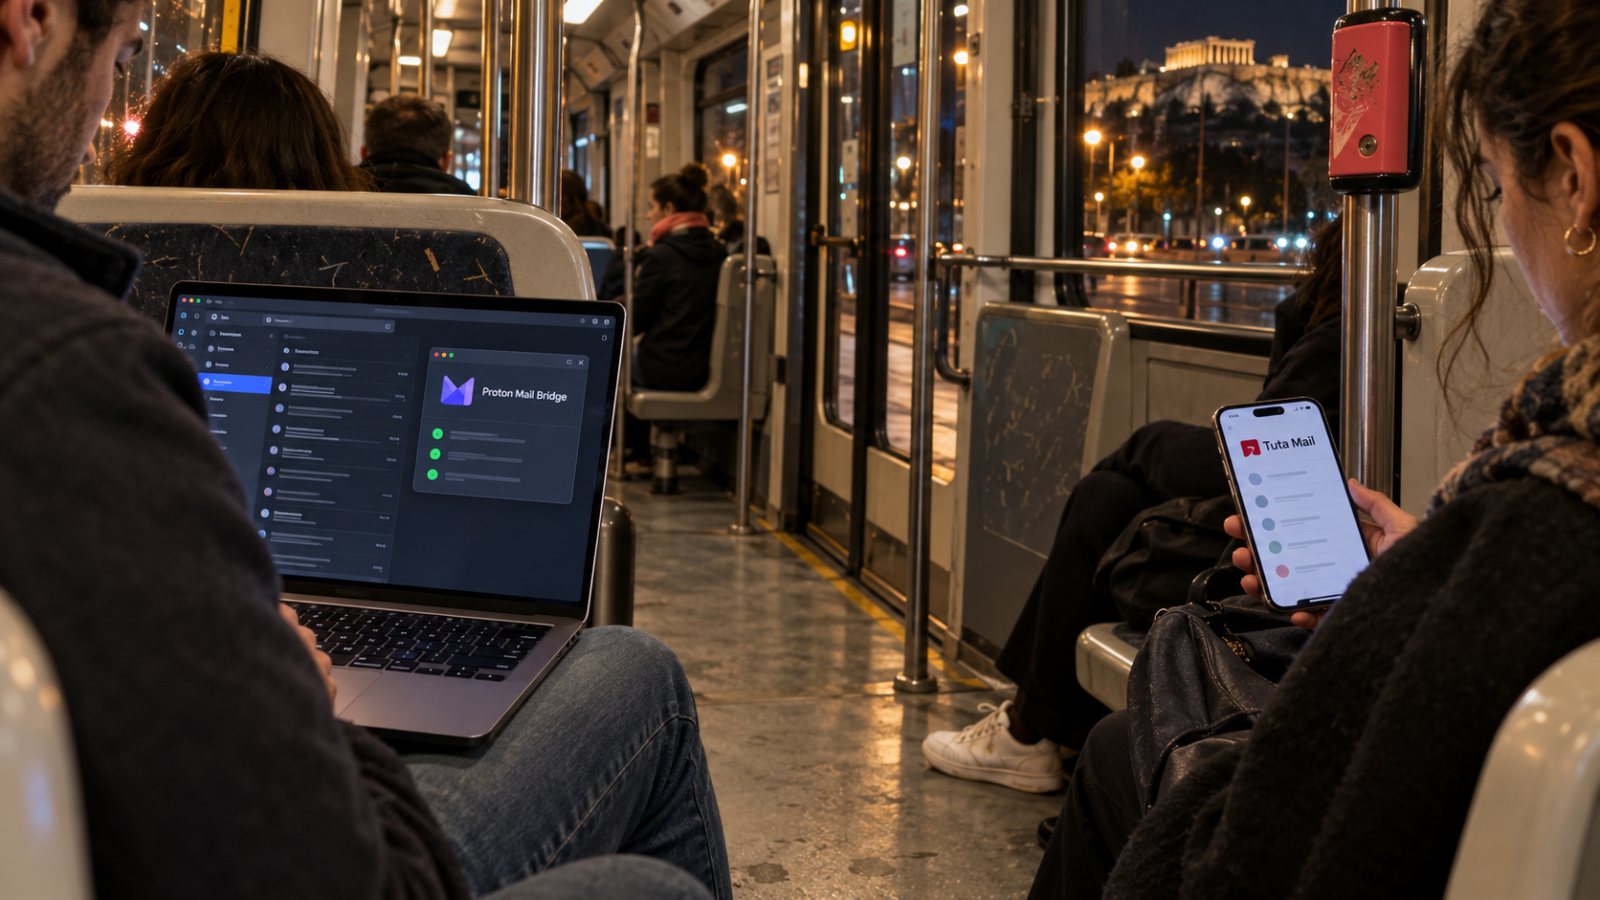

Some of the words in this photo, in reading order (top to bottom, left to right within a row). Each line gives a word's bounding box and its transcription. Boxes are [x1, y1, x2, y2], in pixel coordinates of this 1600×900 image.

[482, 386, 513, 398] Proton
[515, 389, 534, 399] Mail
[536, 390, 567, 403] Bridge
[1262, 440, 1290, 451] Tuta
[1291, 436, 1316, 448] Mail
